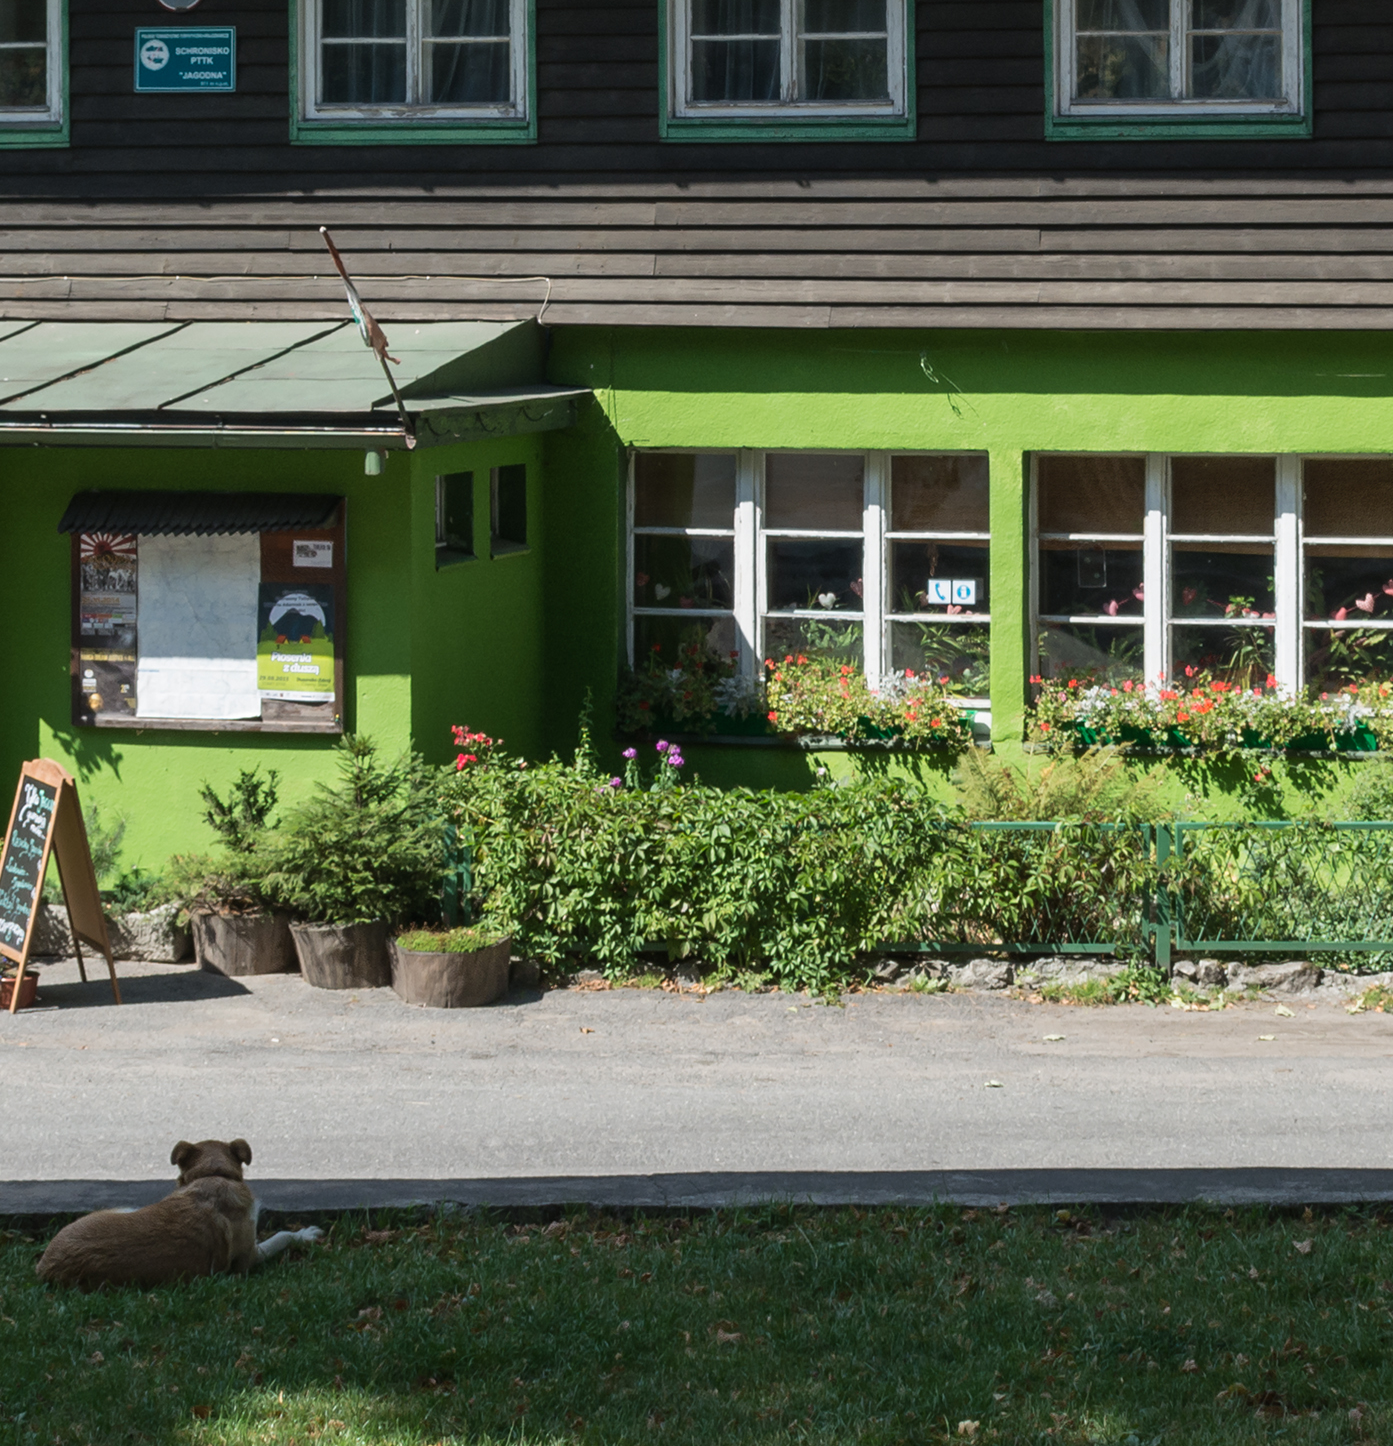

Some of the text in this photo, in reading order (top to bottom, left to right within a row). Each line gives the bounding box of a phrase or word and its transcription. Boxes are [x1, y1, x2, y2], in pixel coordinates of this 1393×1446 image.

[175, 47, 230, 55] SCHRONISKO
[190, 56, 214, 65] PTTK
[282, 663, 290, 672] z
